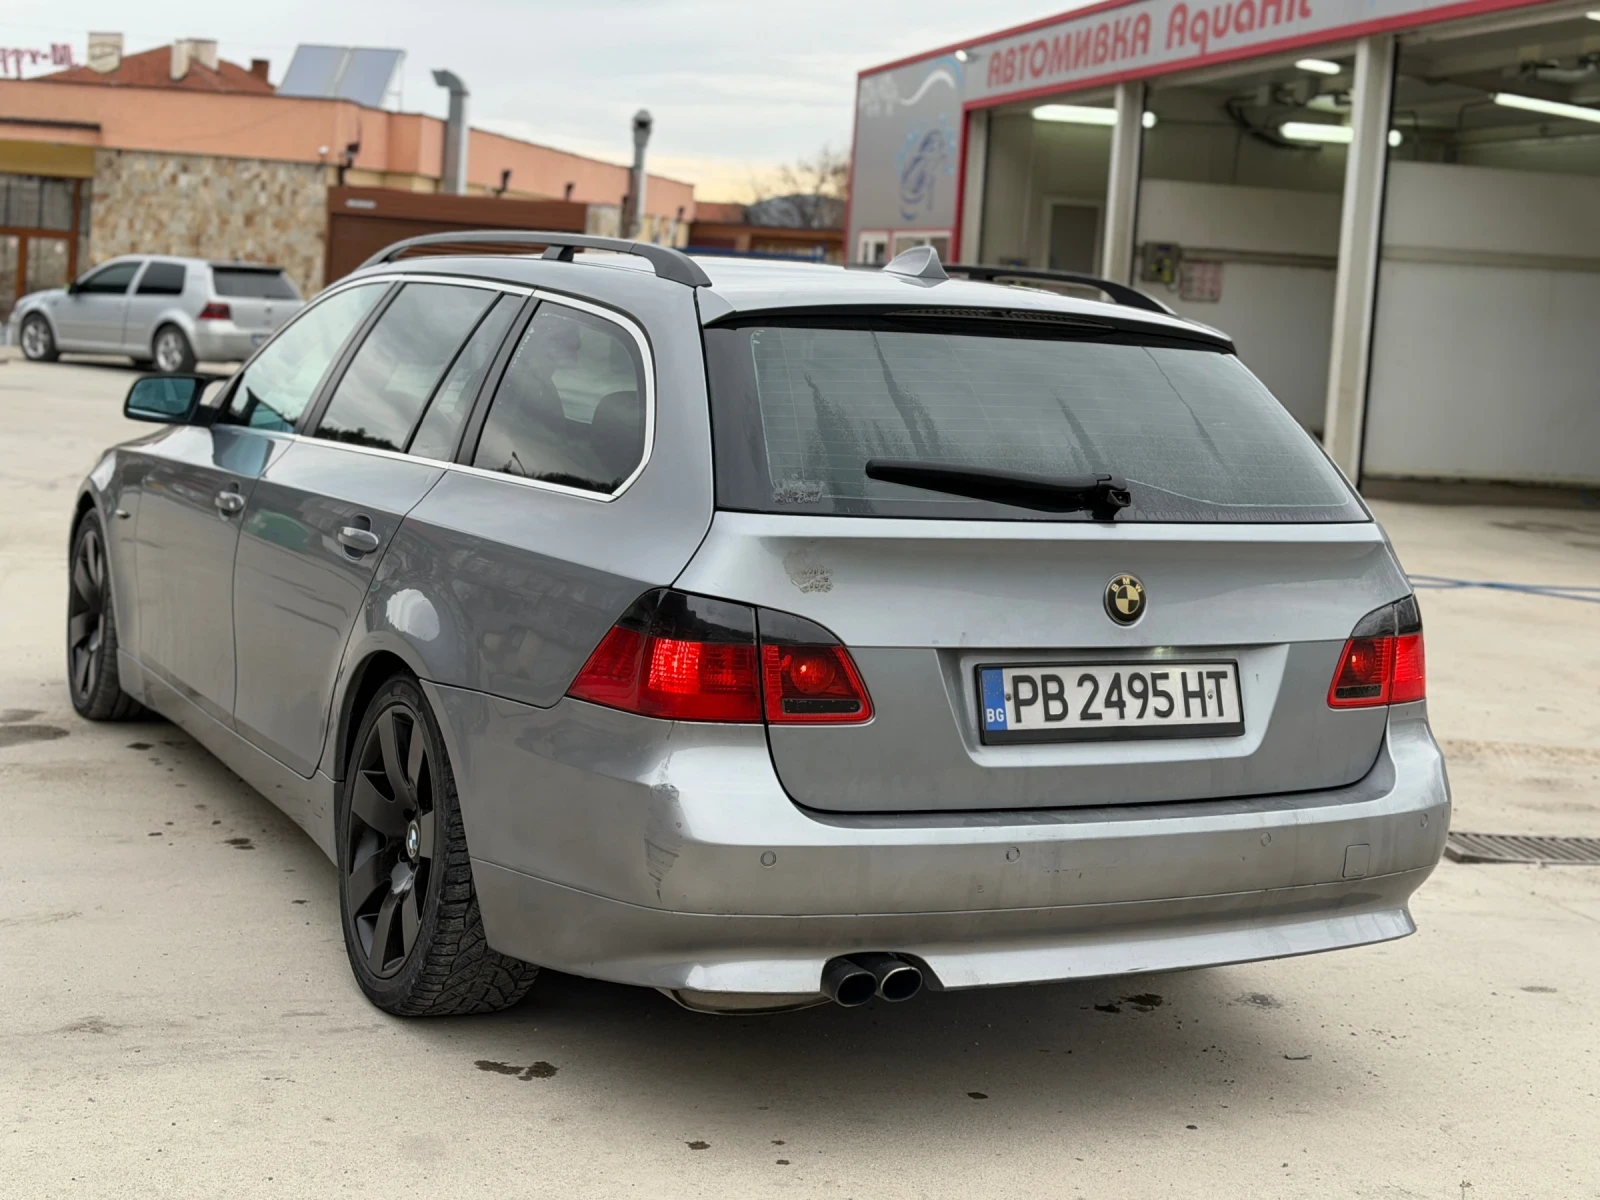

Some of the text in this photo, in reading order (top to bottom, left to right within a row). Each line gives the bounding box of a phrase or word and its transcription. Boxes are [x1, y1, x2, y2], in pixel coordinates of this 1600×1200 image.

[986, 12, 1152, 88] АВТОМИВКА
[1111, 577, 1143, 593] BMW
[1011, 670, 1228, 723] PB 2495 HT
[986, 707, 1005, 723] BG
